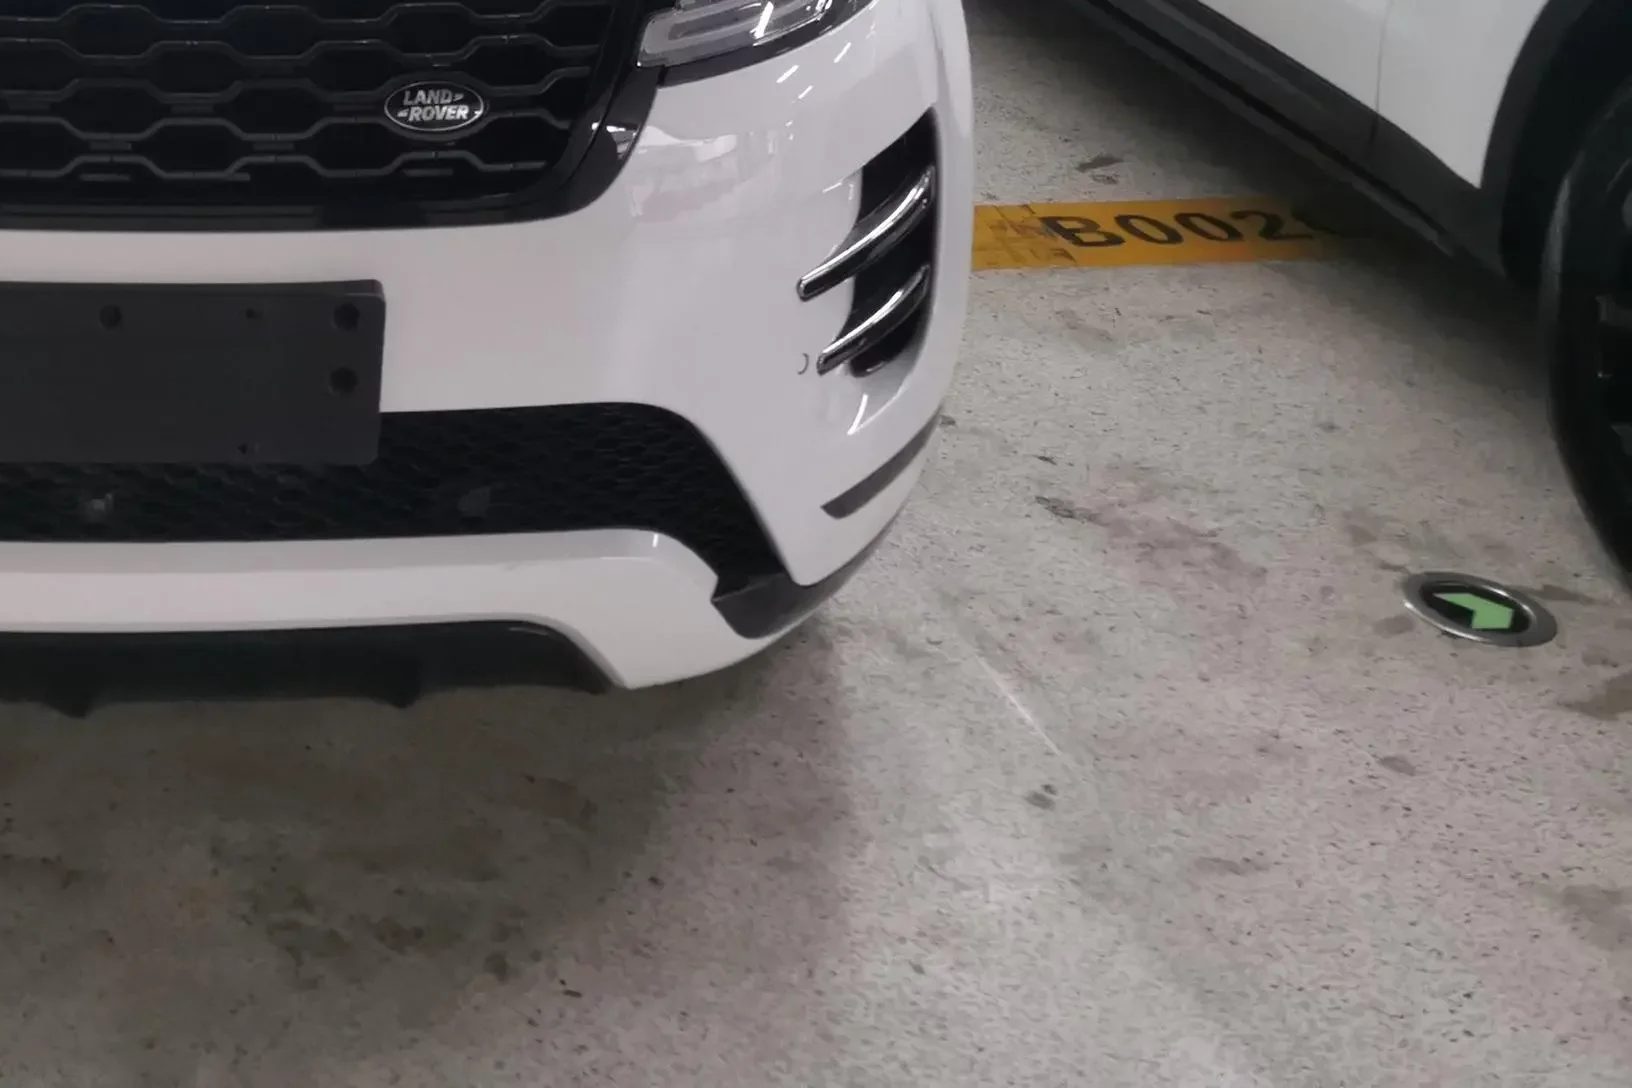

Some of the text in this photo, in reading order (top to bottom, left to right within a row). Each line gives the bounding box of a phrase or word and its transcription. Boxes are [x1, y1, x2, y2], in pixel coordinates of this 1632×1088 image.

[403, 89, 453, 106] LAND
[408, 104, 469, 122] ROVER
[1038, 210, 1314, 248] B002
